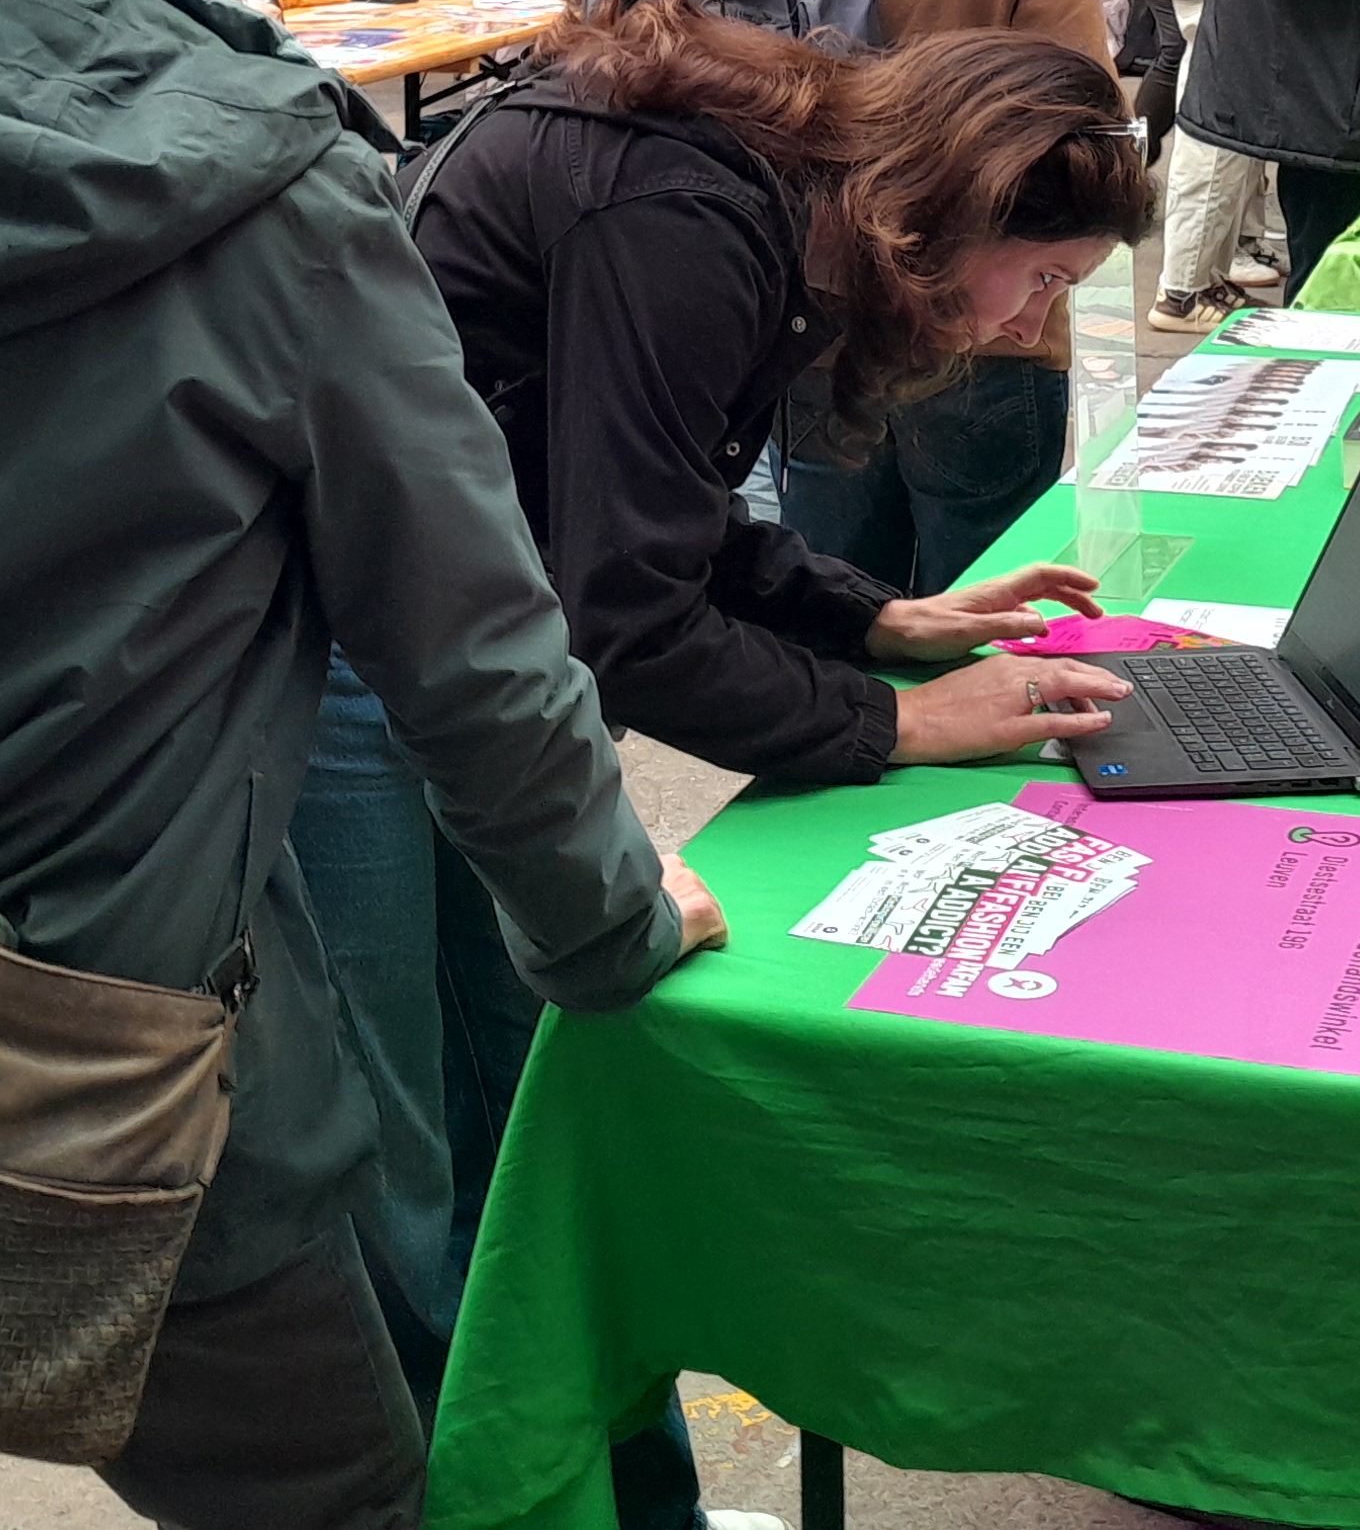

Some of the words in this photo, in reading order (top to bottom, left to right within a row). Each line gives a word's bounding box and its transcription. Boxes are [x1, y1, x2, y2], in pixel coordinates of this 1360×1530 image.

[1265, 851, 1309, 889] Leuven
[1021, 900, 1048, 918] BEN
[1289, 855, 1349, 927] Diestsestraat
[907, 887, 979, 957] ADDICT?
[946, 891, 1020, 962] FASHION
[1010, 919, 1036, 935] JIJ
[997, 936, 1025, 956] EEN
